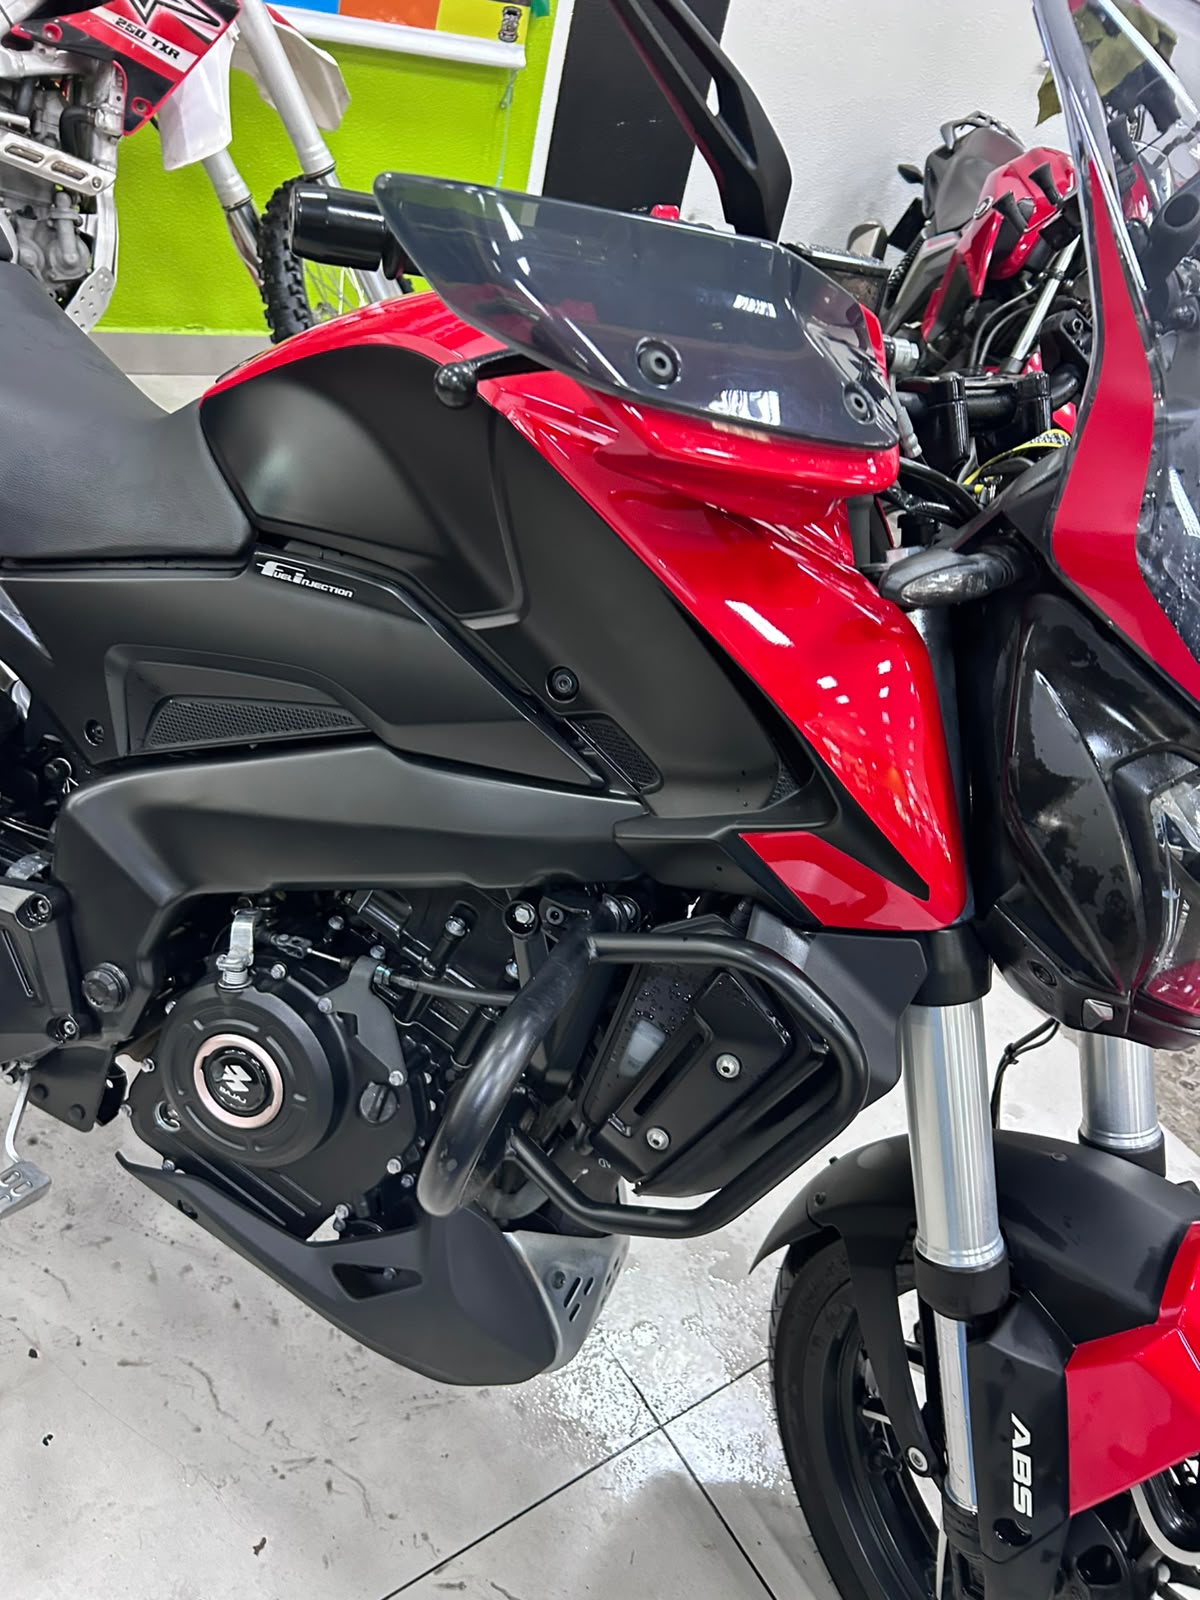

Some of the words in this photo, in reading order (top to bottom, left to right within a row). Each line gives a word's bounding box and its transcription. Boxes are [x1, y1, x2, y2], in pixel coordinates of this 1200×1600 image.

[115, 17, 148, 40] 250
[151, 36, 181, 60] TXR
[1010, 1412, 1033, 1518] ABS
